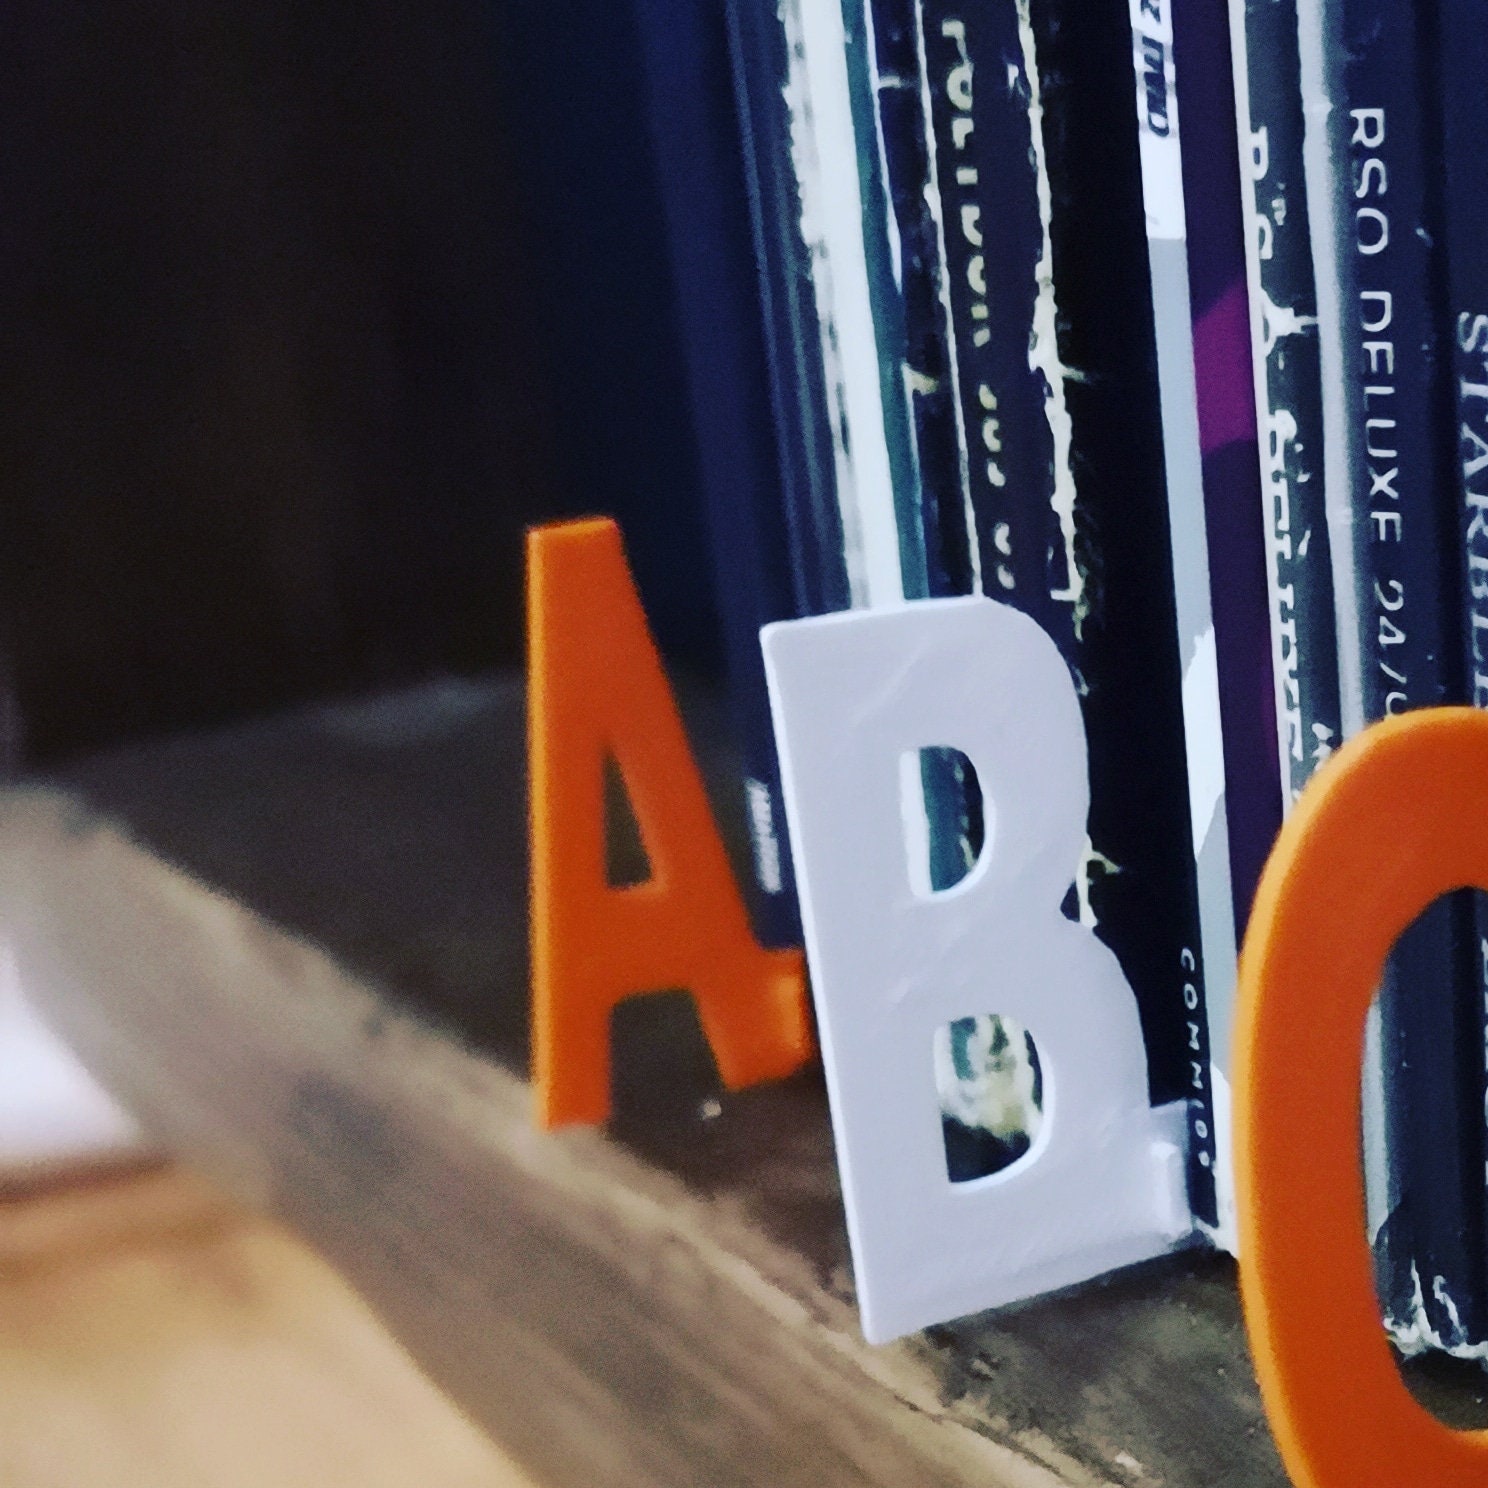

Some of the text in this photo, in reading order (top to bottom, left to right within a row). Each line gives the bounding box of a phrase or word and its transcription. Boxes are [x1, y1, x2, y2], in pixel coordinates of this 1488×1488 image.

[1350, 107, 1389, 256] RSO
[1357, 290, 1402, 543] DELUXE
[525, 515, 812, 1133] A
[759, 595, 1190, 1346] B
